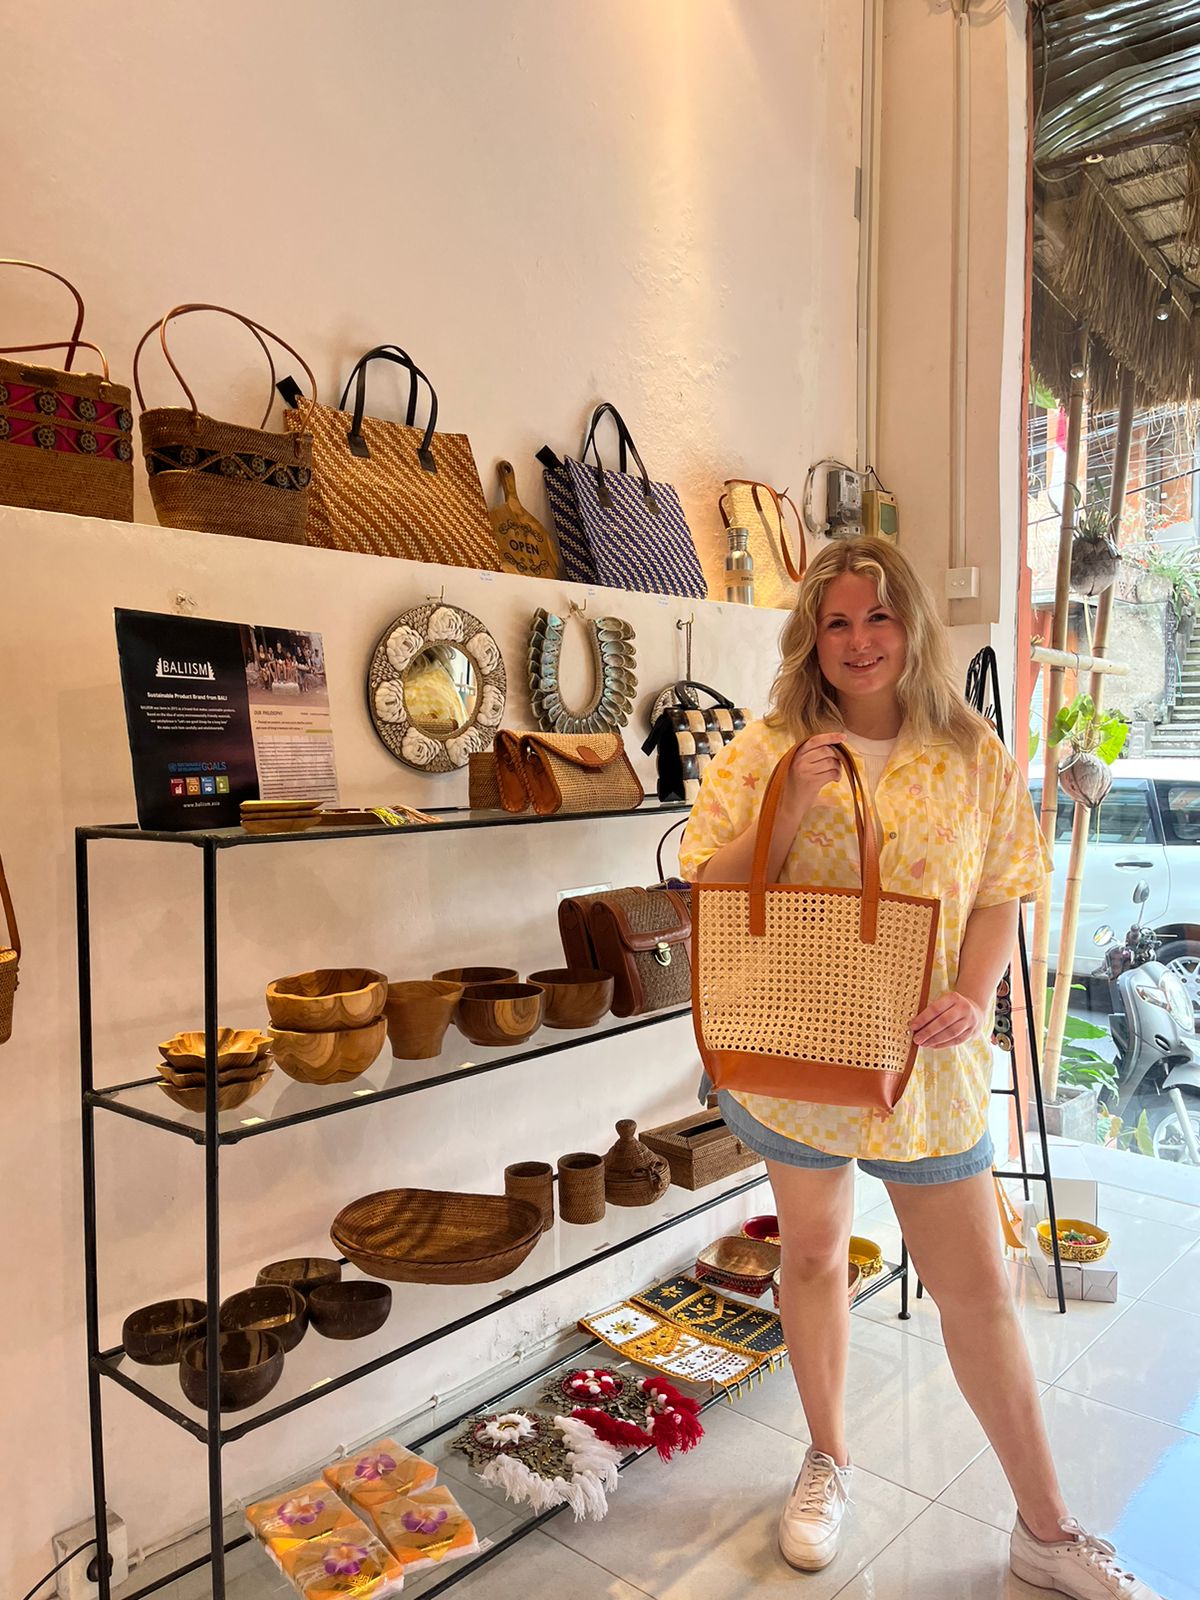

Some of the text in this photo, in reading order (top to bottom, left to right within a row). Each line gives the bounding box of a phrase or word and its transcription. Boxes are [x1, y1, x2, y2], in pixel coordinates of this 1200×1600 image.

[509, 539, 540, 556] OPEN
[162, 660, 208, 676] BALIISM
[202, 762, 227, 771] GOALS
